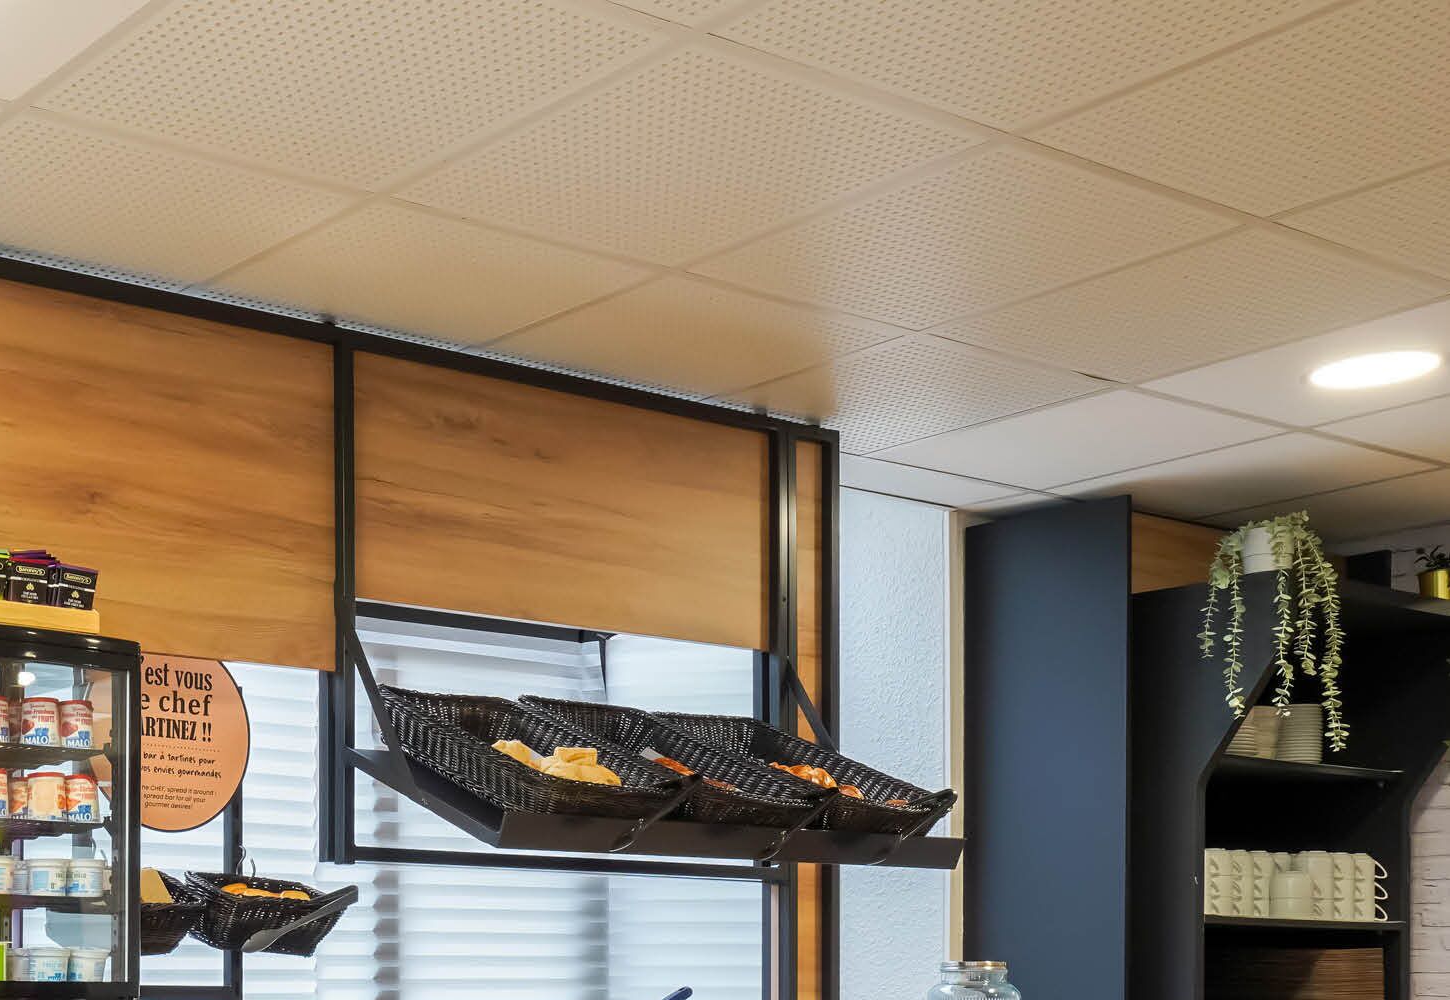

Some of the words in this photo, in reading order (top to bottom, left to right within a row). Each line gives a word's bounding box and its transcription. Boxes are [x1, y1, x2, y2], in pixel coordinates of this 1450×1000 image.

[174, 670, 213, 692] vous
[141, 692, 151, 710] e
[158, 690, 213, 717] chef
[202, 721, 212, 743] !!
[25, 734, 49, 745] MALO
[67, 739, 90, 748] MALO
[143, 751, 157, 759] bar
[159, 751, 165, 760] à
[167, 753, 196, 764] tartines
[199, 757, 216, 766] pour
[154, 766, 175, 775] envies
[177, 768, 222, 778] gourmandes
[144, 801, 170, 810] gourmet
[68, 812, 91, 822] MALO
